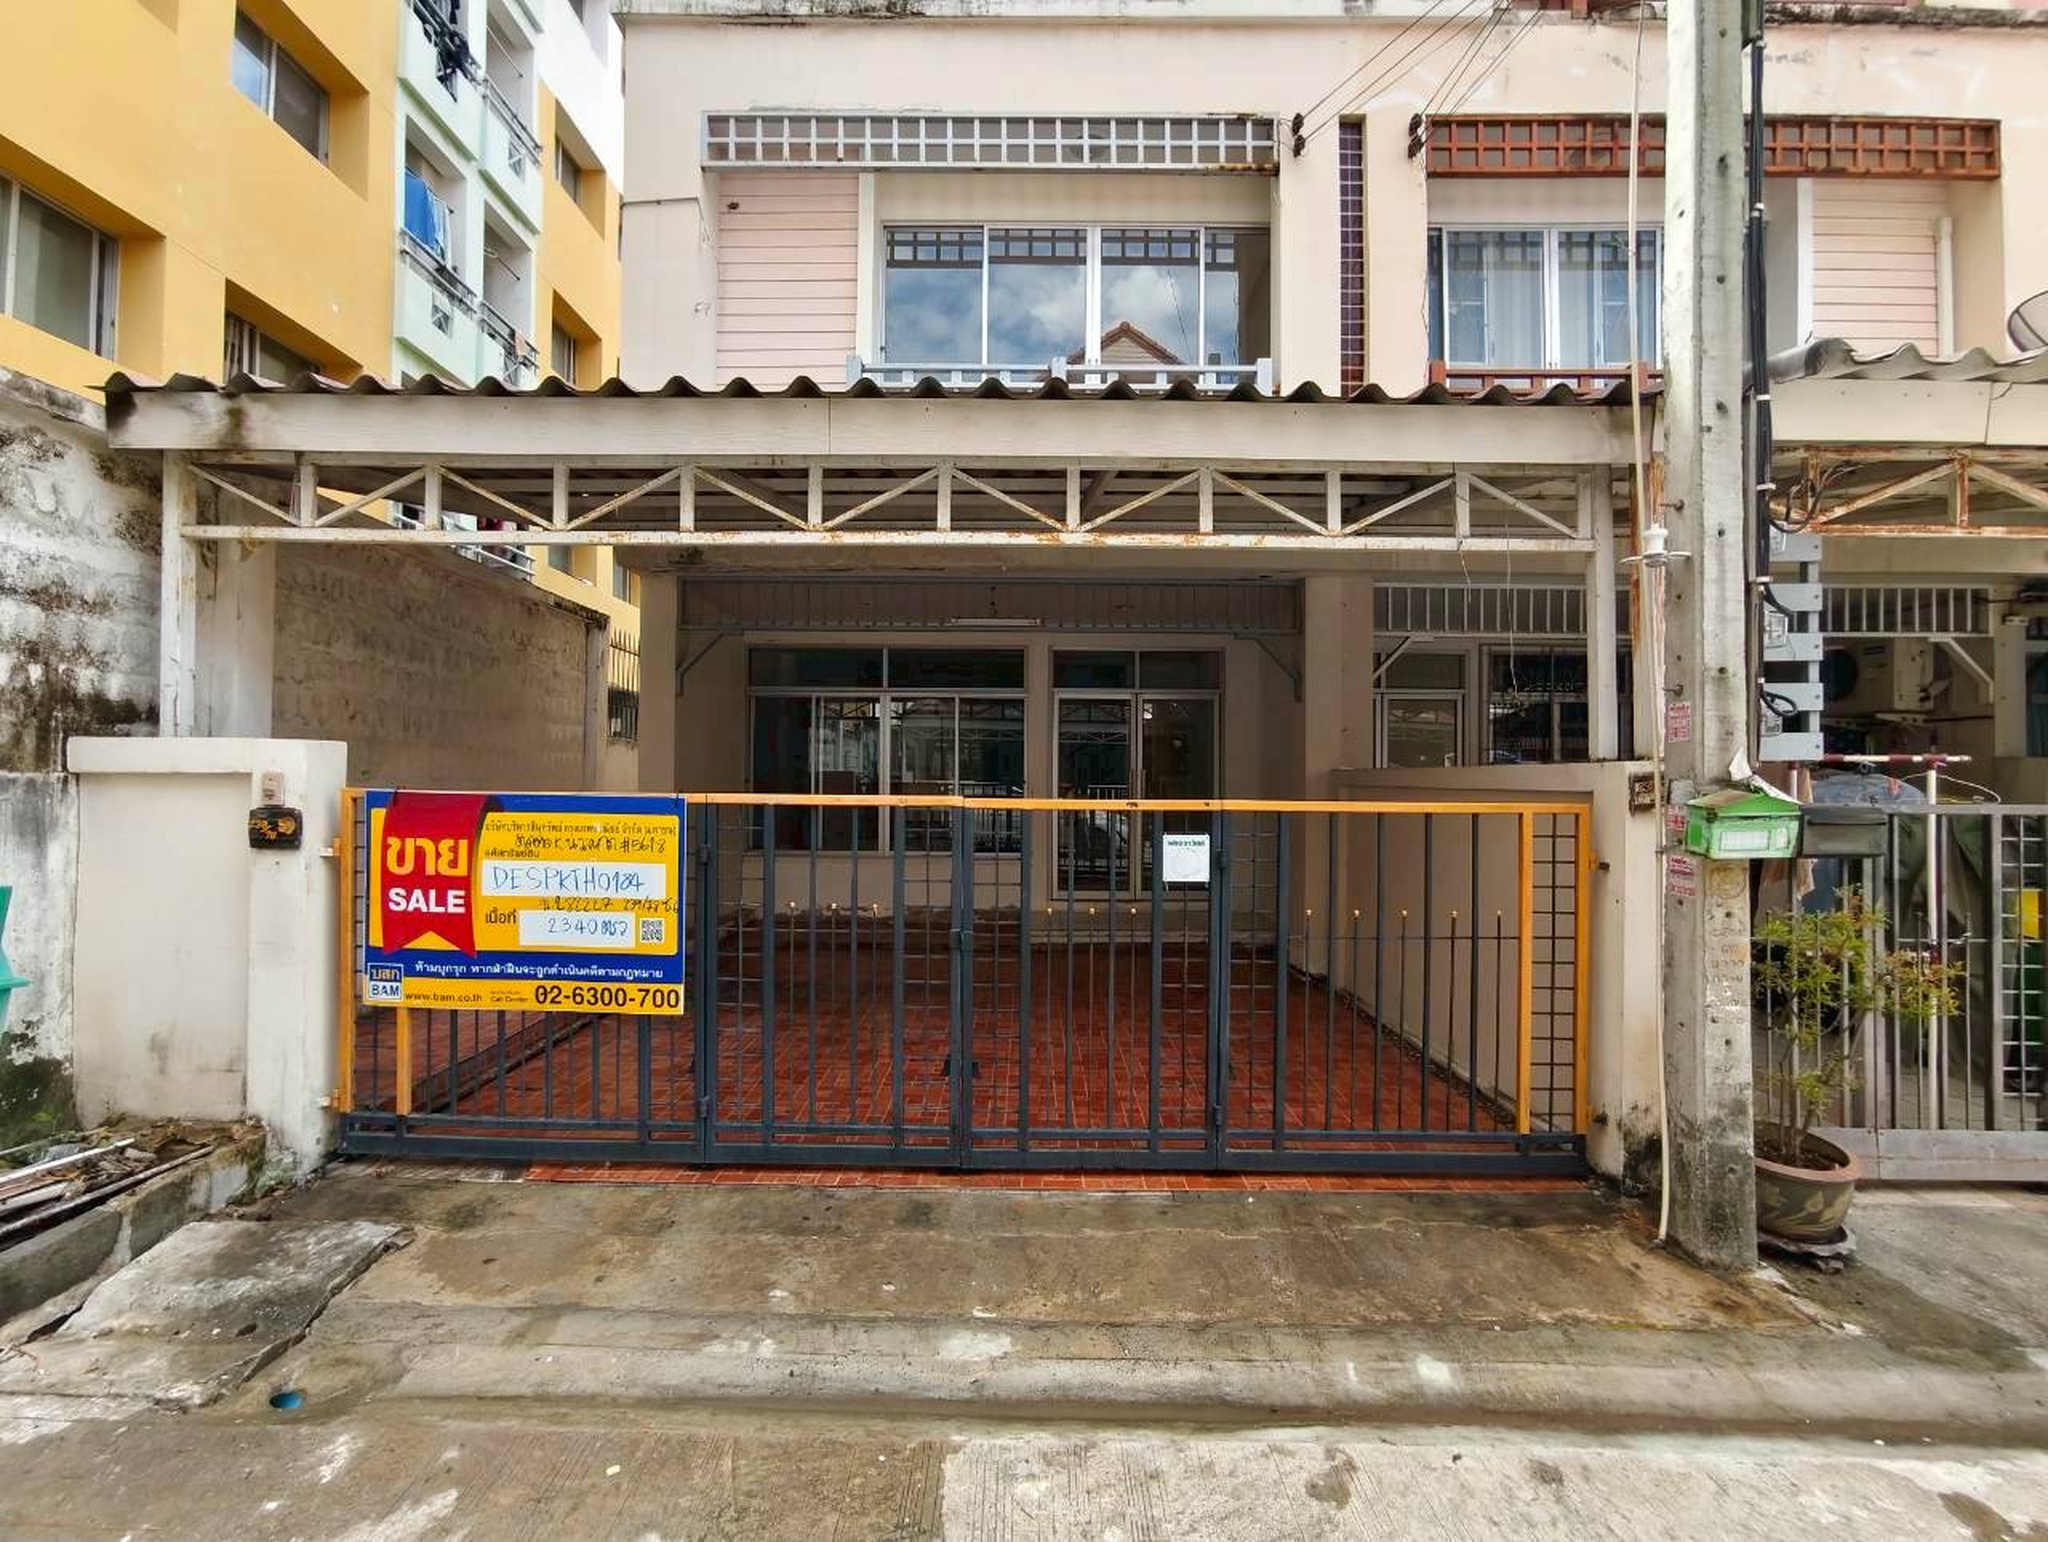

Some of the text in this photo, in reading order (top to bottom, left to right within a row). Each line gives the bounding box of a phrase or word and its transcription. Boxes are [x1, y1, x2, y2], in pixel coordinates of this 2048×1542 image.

[387, 836, 469, 876] ขาย
[389, 888, 466, 914] SALE
[371, 968, 400, 982] บสก
[414, 960, 467, 976] ห้ามบุกรุก
[371, 985, 400, 999] BAM
[405, 991, 483, 1003] www.bam.co.th
[535, 985, 680, 1009] 02-6300-700
